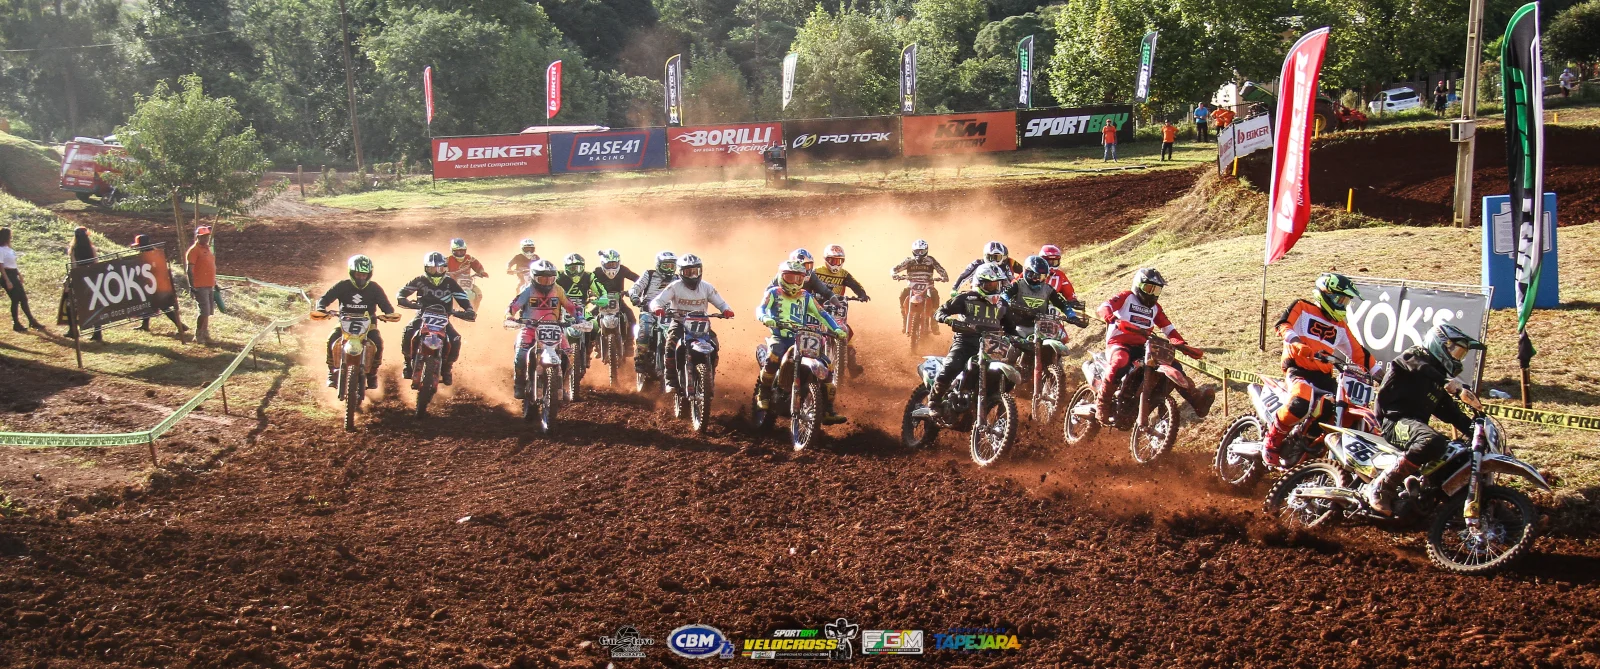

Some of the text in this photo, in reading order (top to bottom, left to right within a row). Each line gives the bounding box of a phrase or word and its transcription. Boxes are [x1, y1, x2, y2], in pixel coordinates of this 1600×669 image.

[934, 119, 988, 138] KTM
[1024, 113, 1129, 137] SPORTBAY
[690, 127, 772, 146] BORILLI
[818, 132, 892, 144] PRO TORK
[727, 143, 768, 154] Racing
[529, 297, 559, 309] FXR
[974, 305, 1000, 319] FLY
[348, 321, 364, 335] 6
[690, 321, 707, 333] 11
[538, 329, 561, 341] 636
[803, 335, 818, 350] 12
[1224, 368, 1241, 379] PRO
[1345, 380, 1372, 405] 101
[1262, 393, 1283, 414] 101
[1481, 405, 1600, 430] RO TORK PRO
[1345, 441, 1376, 462] 86
